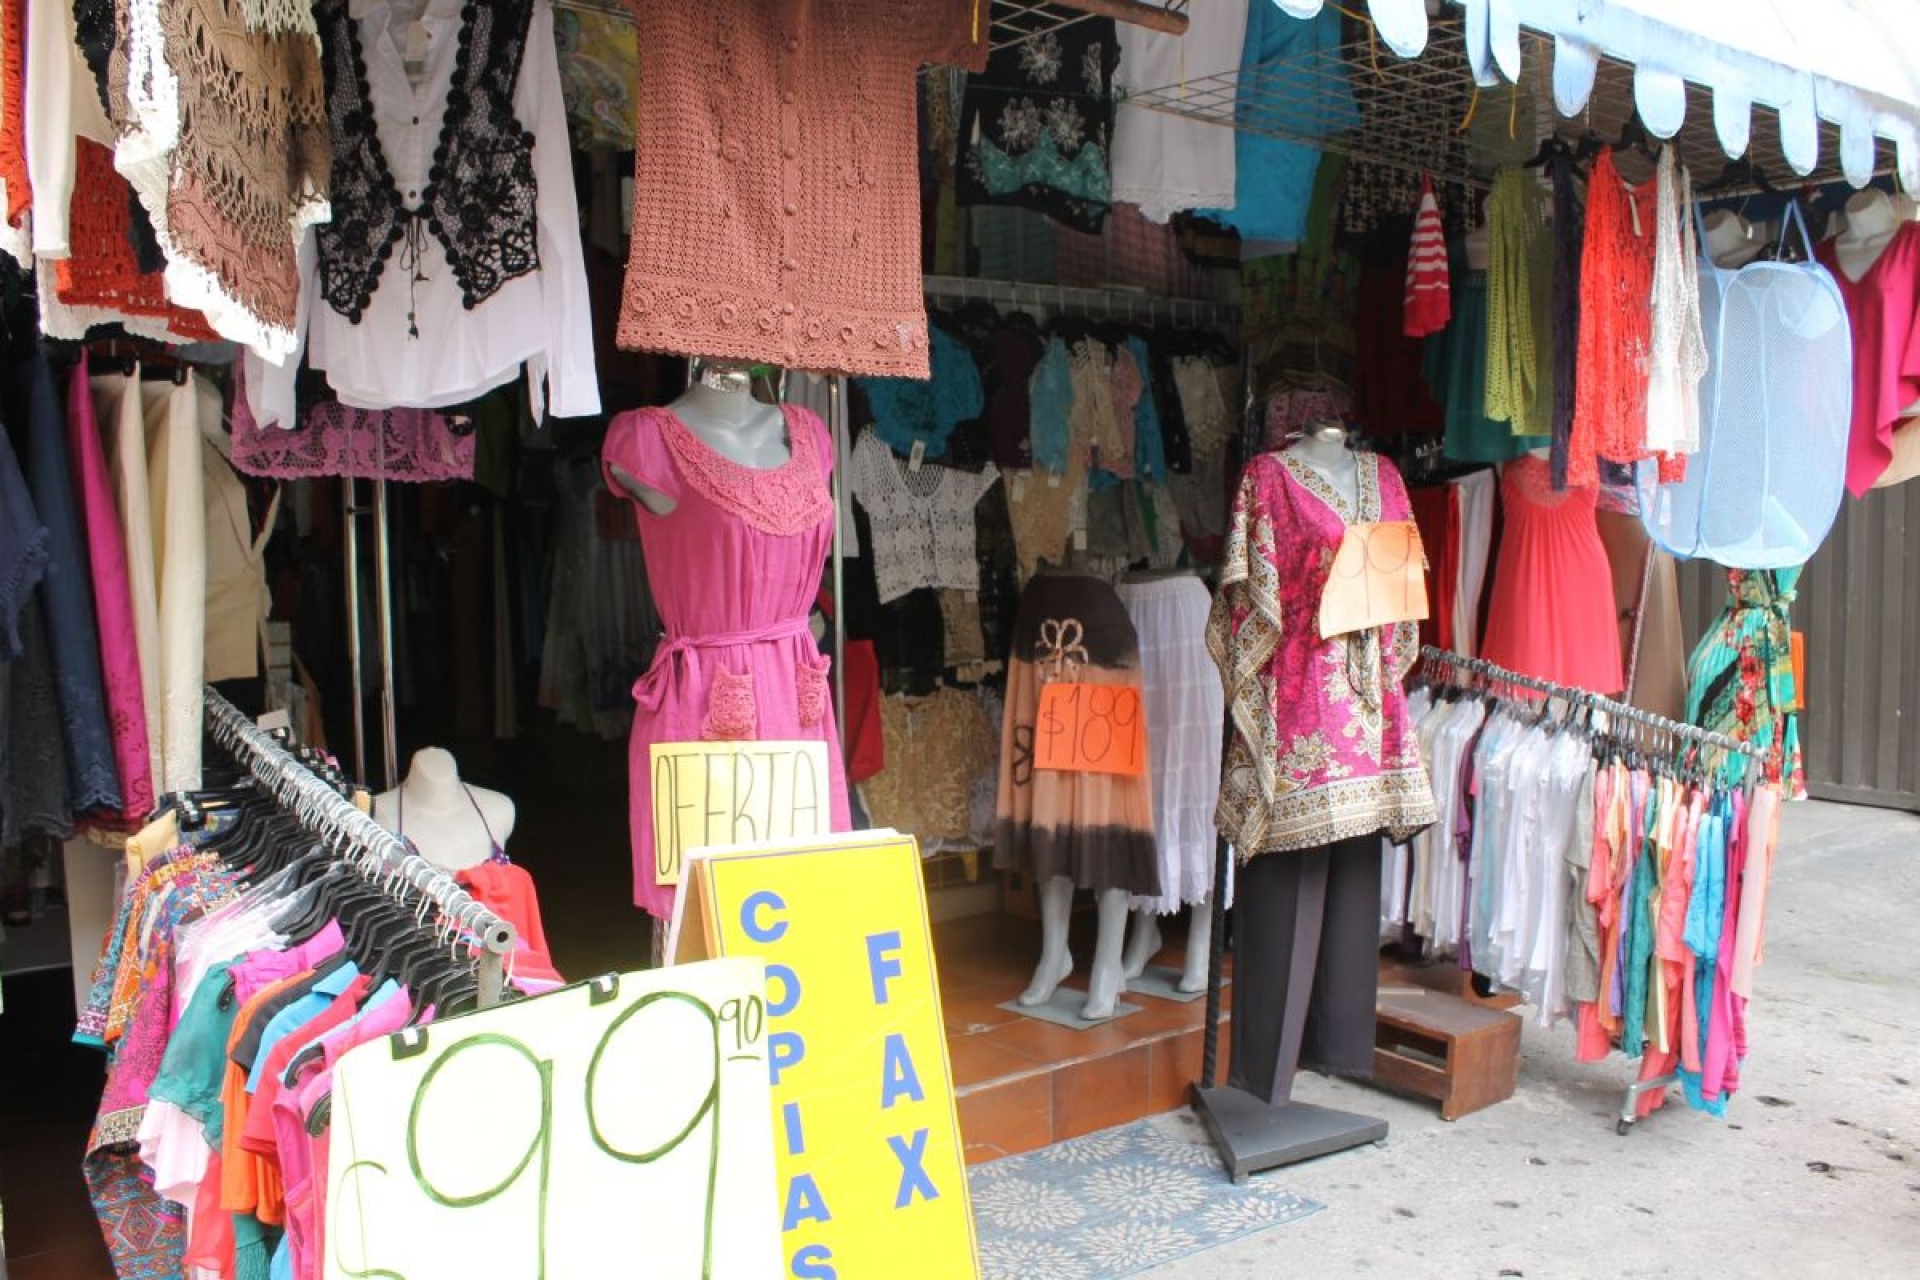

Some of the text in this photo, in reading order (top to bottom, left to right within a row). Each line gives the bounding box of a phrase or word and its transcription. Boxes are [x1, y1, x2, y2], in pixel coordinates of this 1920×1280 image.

[1042, 684, 1140, 767] $189
[740, 890, 837, 1280] COPIAS
[865, 930, 940, 1210] FAX
